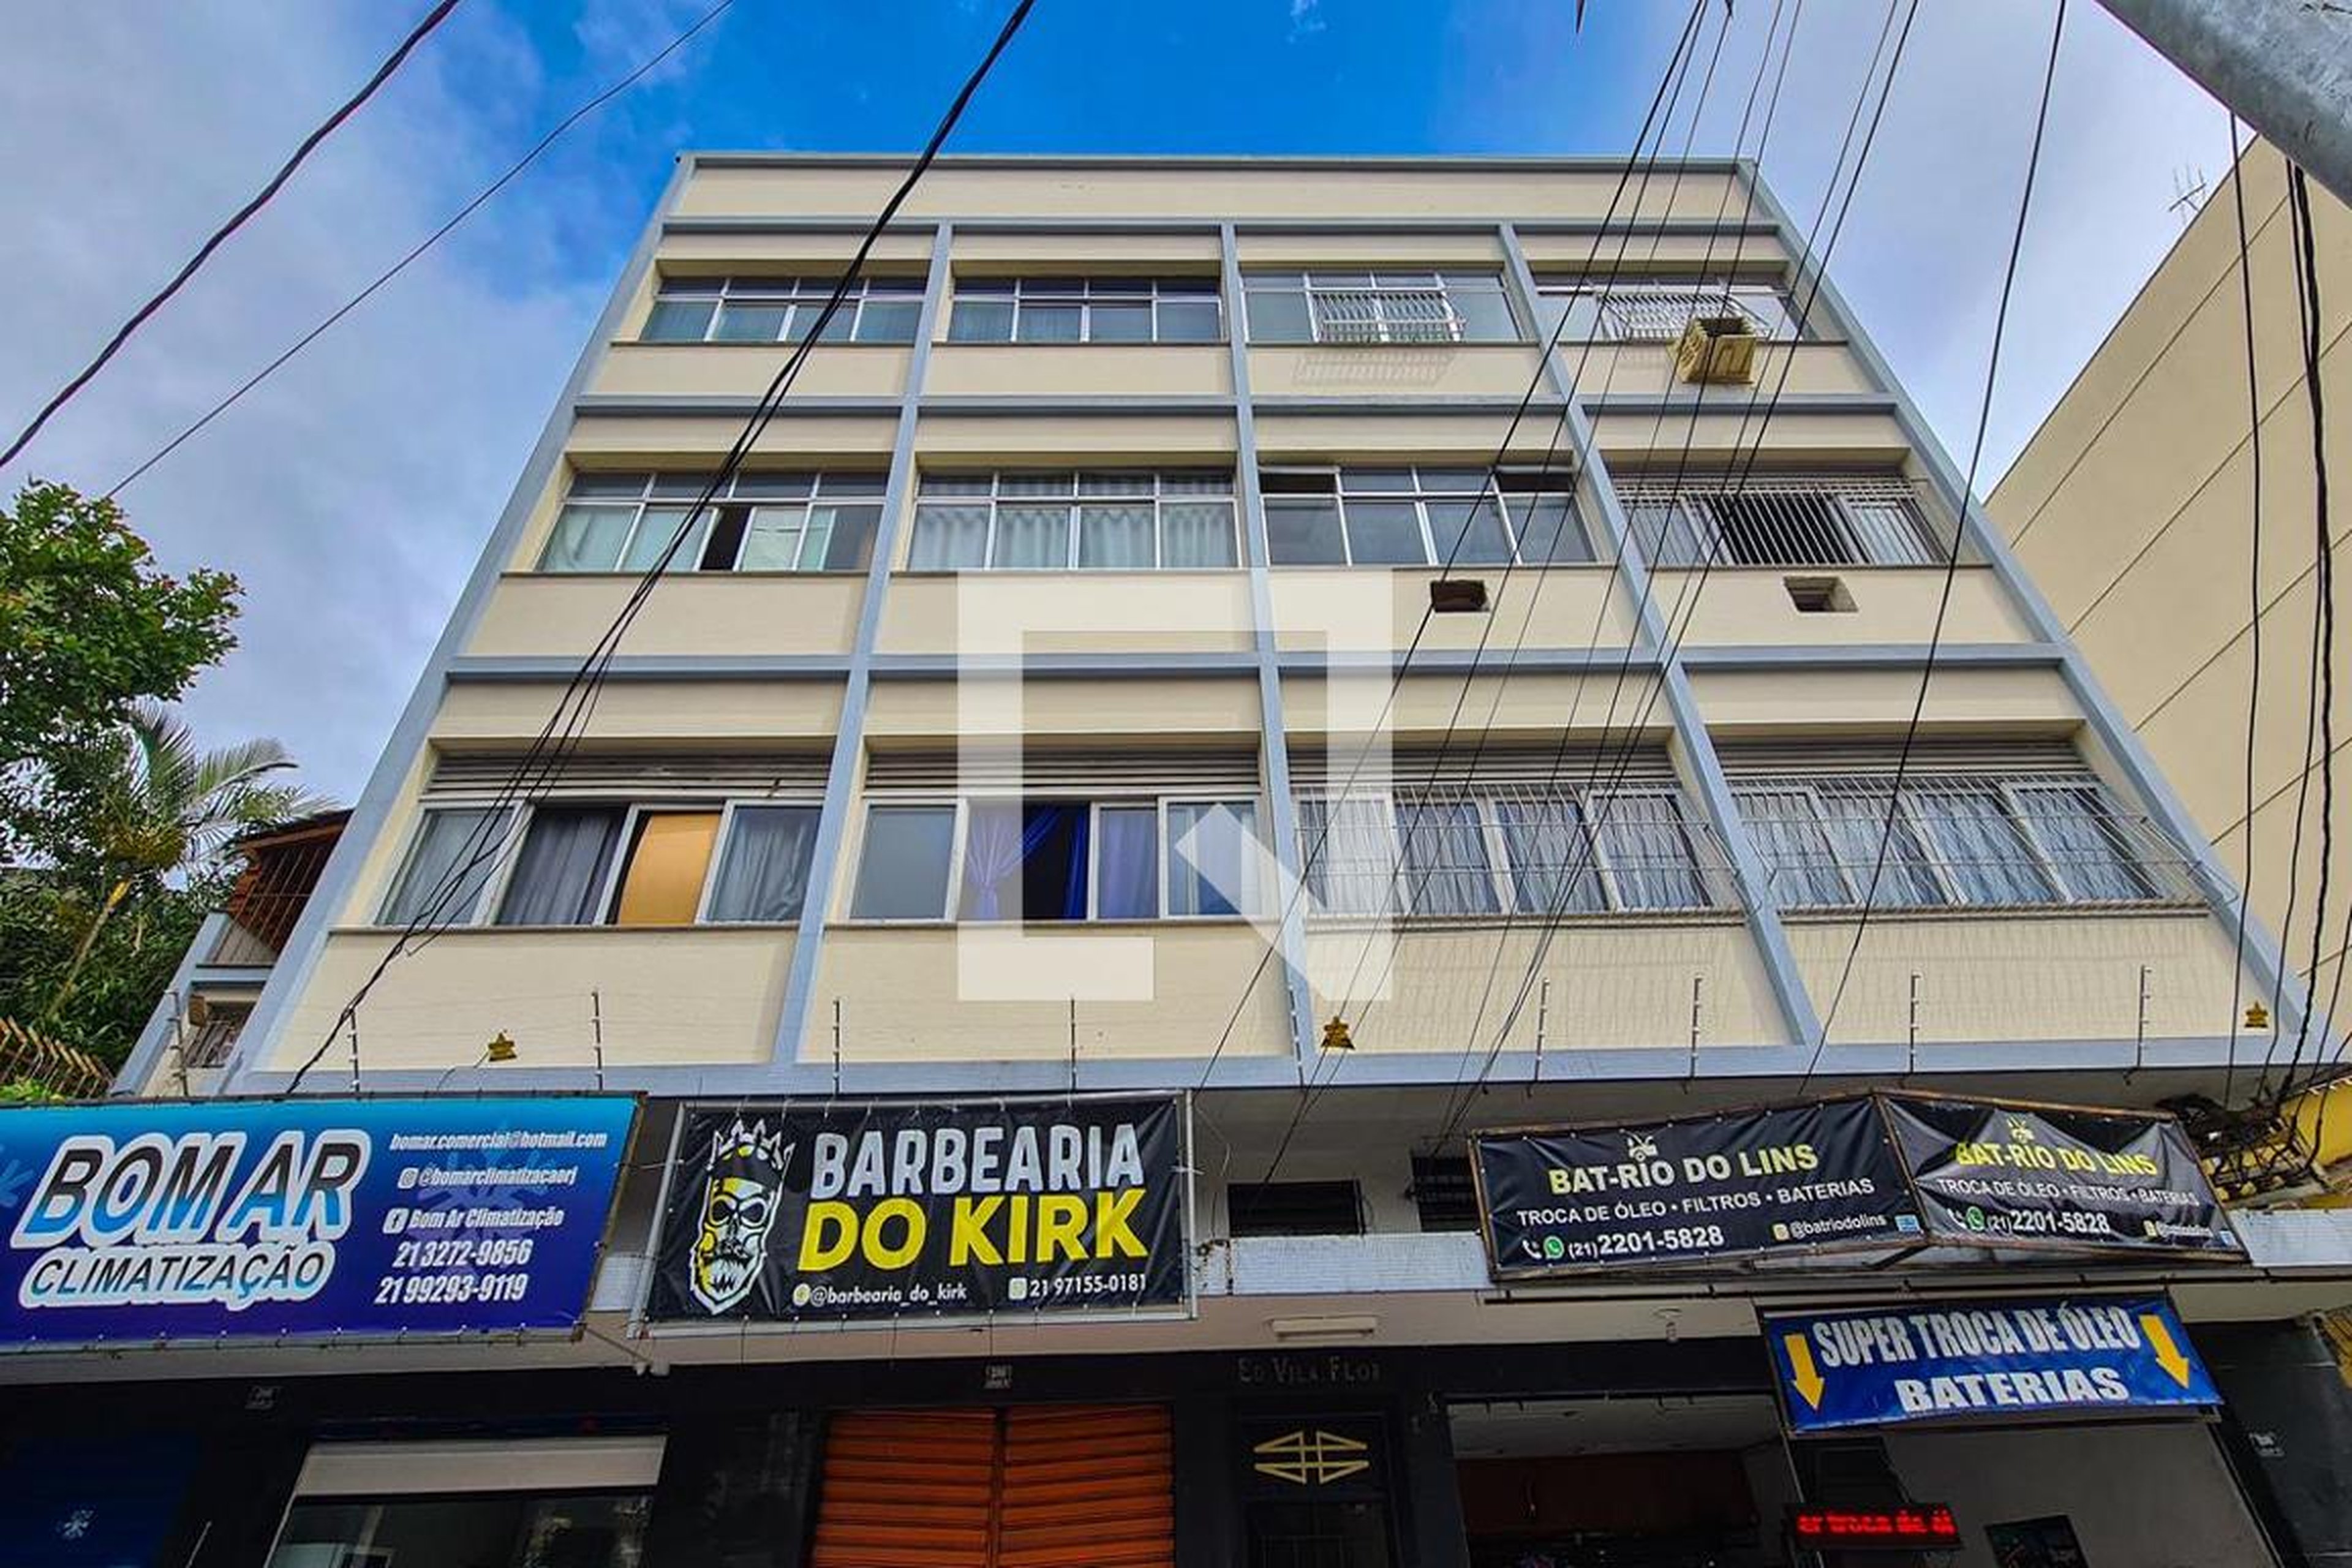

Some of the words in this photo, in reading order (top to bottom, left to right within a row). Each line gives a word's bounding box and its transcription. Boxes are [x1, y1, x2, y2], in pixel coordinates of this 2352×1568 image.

[810, 1123, 1145, 1200] BARBEARIA
[1548, 1161, 1676, 1195] BAT-RIO
[1683, 1154, 1732, 1183] DO
[1738, 1144, 1819, 1177] LINS
[1956, 1142, 2056, 1169] BAT-RIO
[2056, 1147, 2097, 1172] DO
[2093, 1152, 2158, 1175] LINS
[17, 1139, 241, 1240] BOM
[218, 1138, 364, 1232] AR
[1517, 1208, 1582, 1226] TROCA
[1584, 1205, 1611, 1222] DE
[1613, 1200, 1667, 1220] ÓLEO
[1681, 1191, 1762, 1214] FILTROS
[1776, 1177, 1876, 1205] BATERIAS
[1937, 1178, 1993, 1195] TROCA
[1991, 1180, 2016, 1196] DE
[409, 1208, 446, 1229] Bom
[445, 1208, 464, 1227] Ar
[464, 1206, 565, 1229] Climatização
[798, 1196, 927, 1272] DO
[949, 1188, 1149, 1268] KIRK
[1597, 1225, 1725, 1255] 2201-5828
[29, 1242, 327, 1300] CLIMATIZAÇÃO
[419, 1238, 534, 1268] 3272-9856
[402, 1273, 529, 1303] 99293-9119
[1030, 1279, 1048, 1297] 21
[1053, 1273, 1147, 1297] 97155-0181
[1812, 1315, 1917, 1368] SUPER
[1910, 1310, 2023, 1359] TROCA
[2018, 1308, 2070, 1353] DE
[2059, 1300, 2142, 1351] ÓLEO
[1894, 1367, 2131, 1413] BATERIAS
